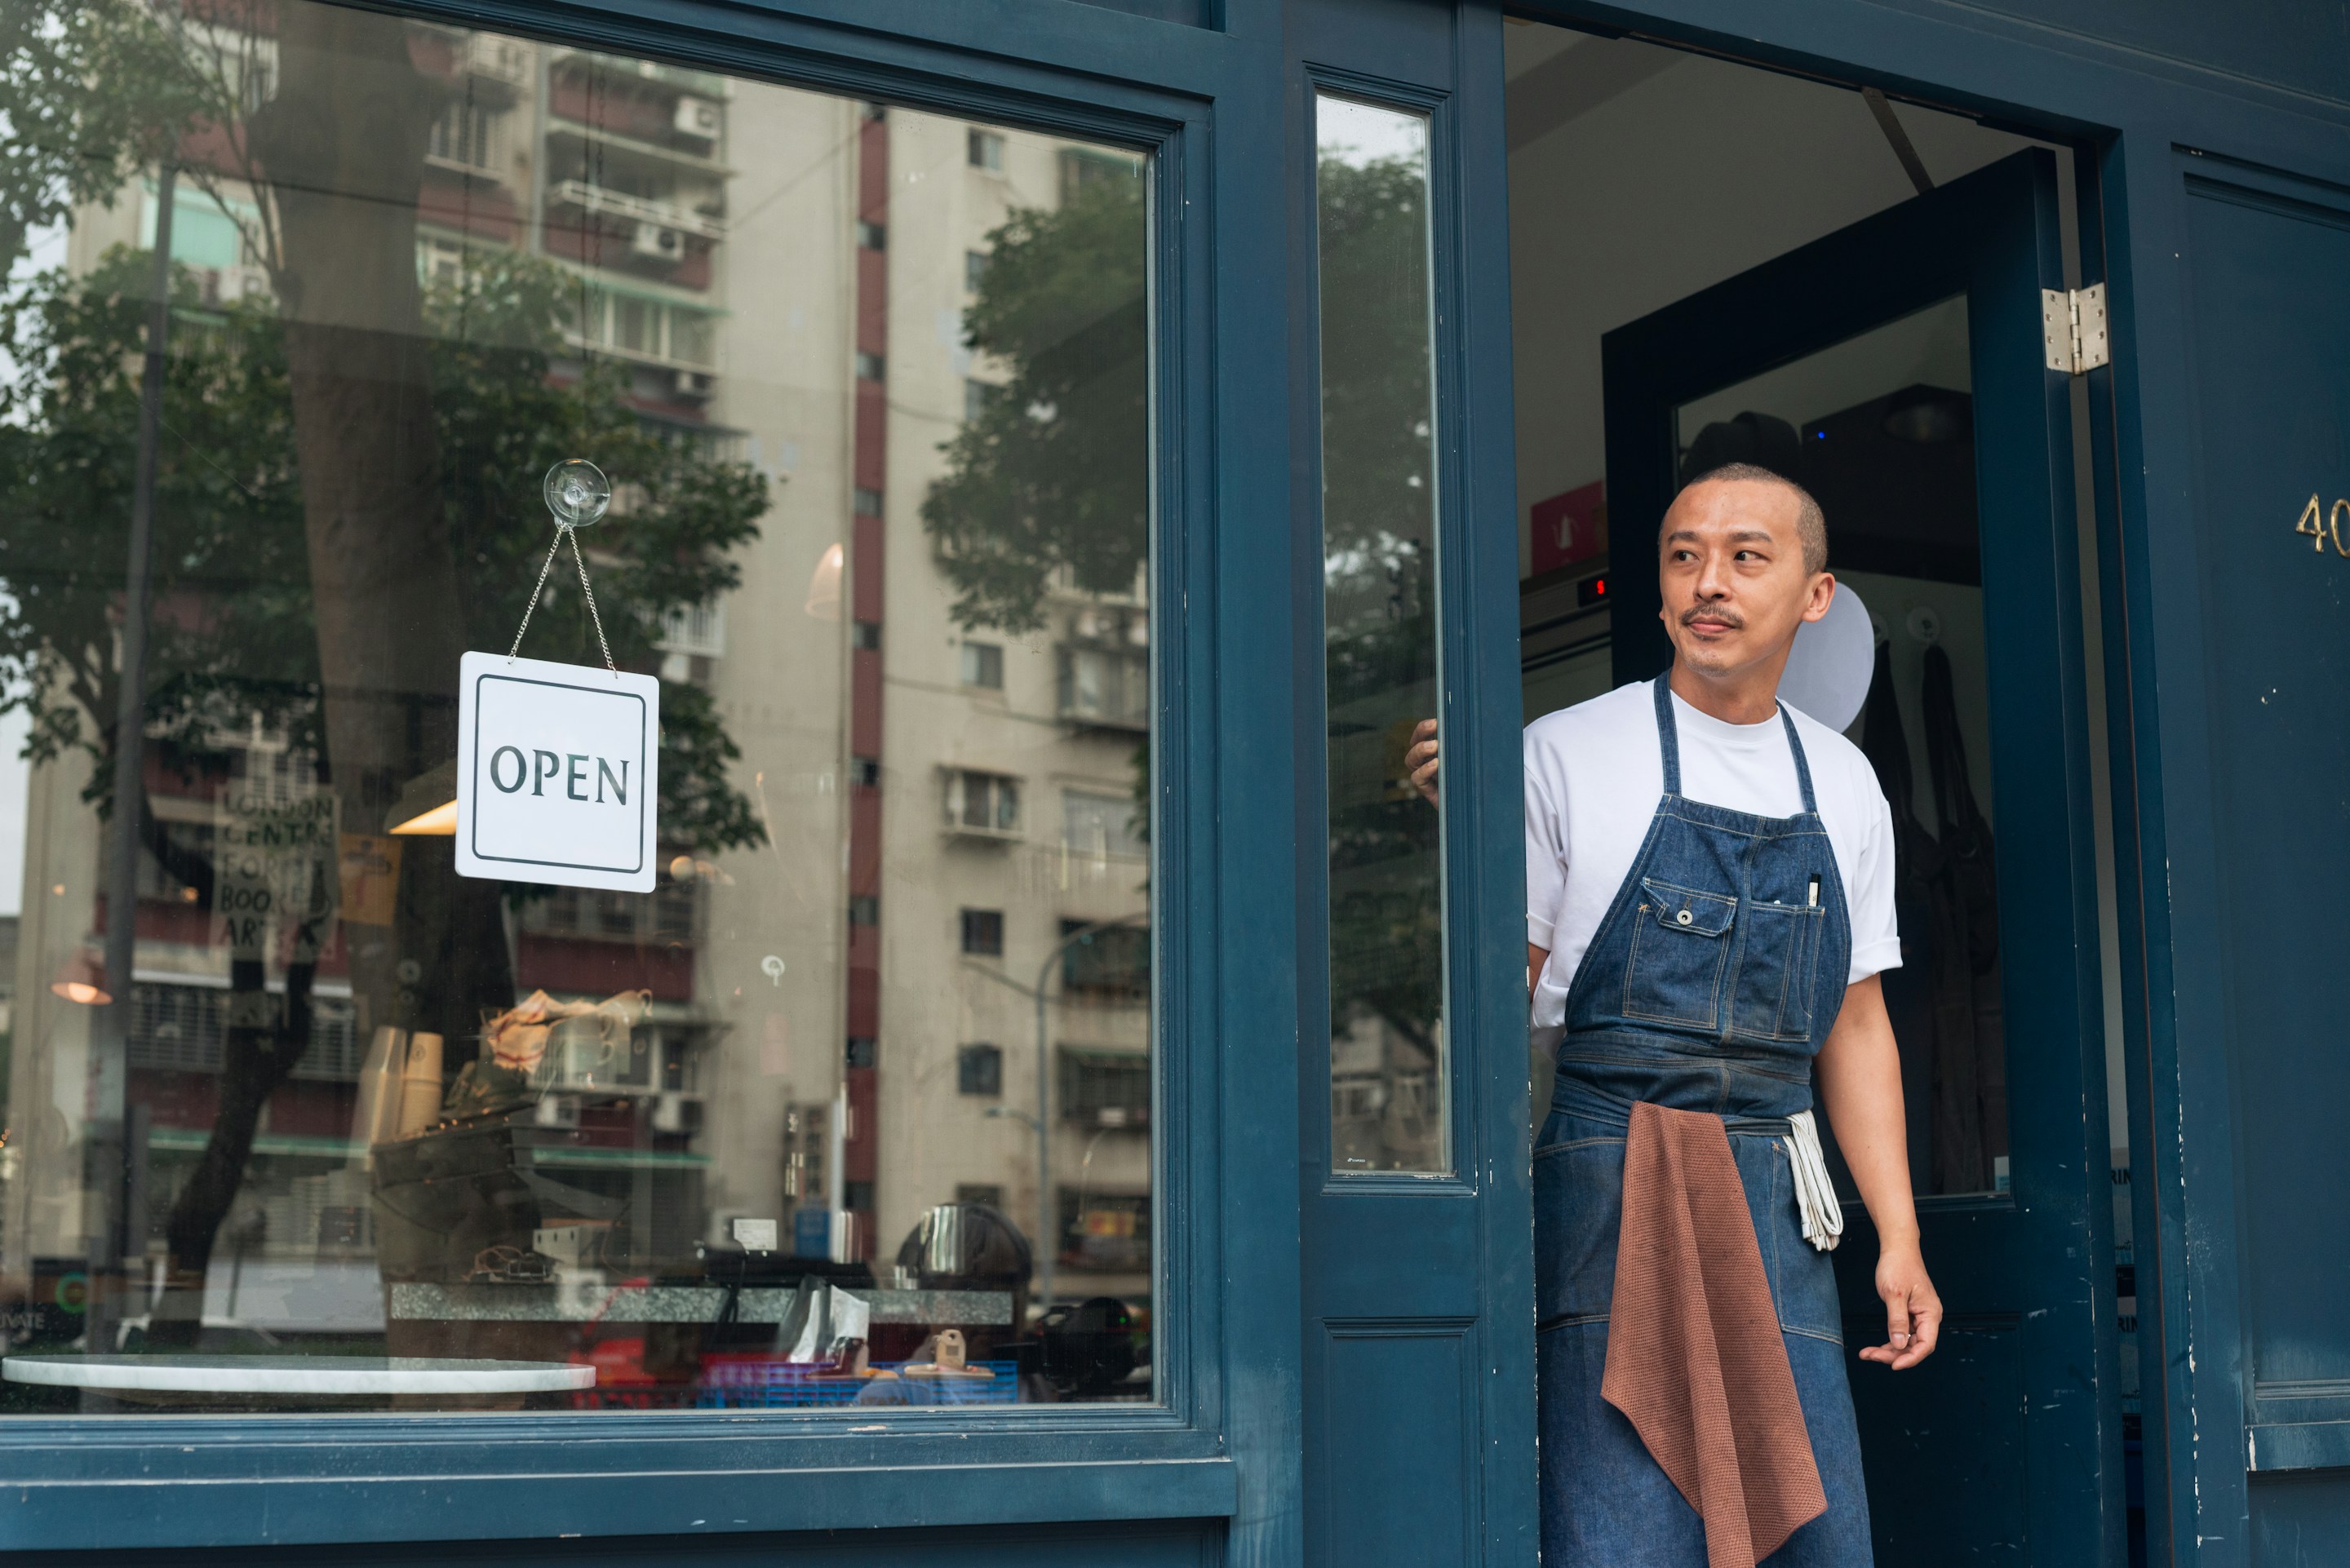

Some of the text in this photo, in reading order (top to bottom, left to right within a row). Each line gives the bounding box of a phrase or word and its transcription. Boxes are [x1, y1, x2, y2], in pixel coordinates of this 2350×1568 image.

[2295, 492, 2350, 558] 40
[223, 791, 333, 818] LONDON
[490, 745, 630, 806] OPEN
